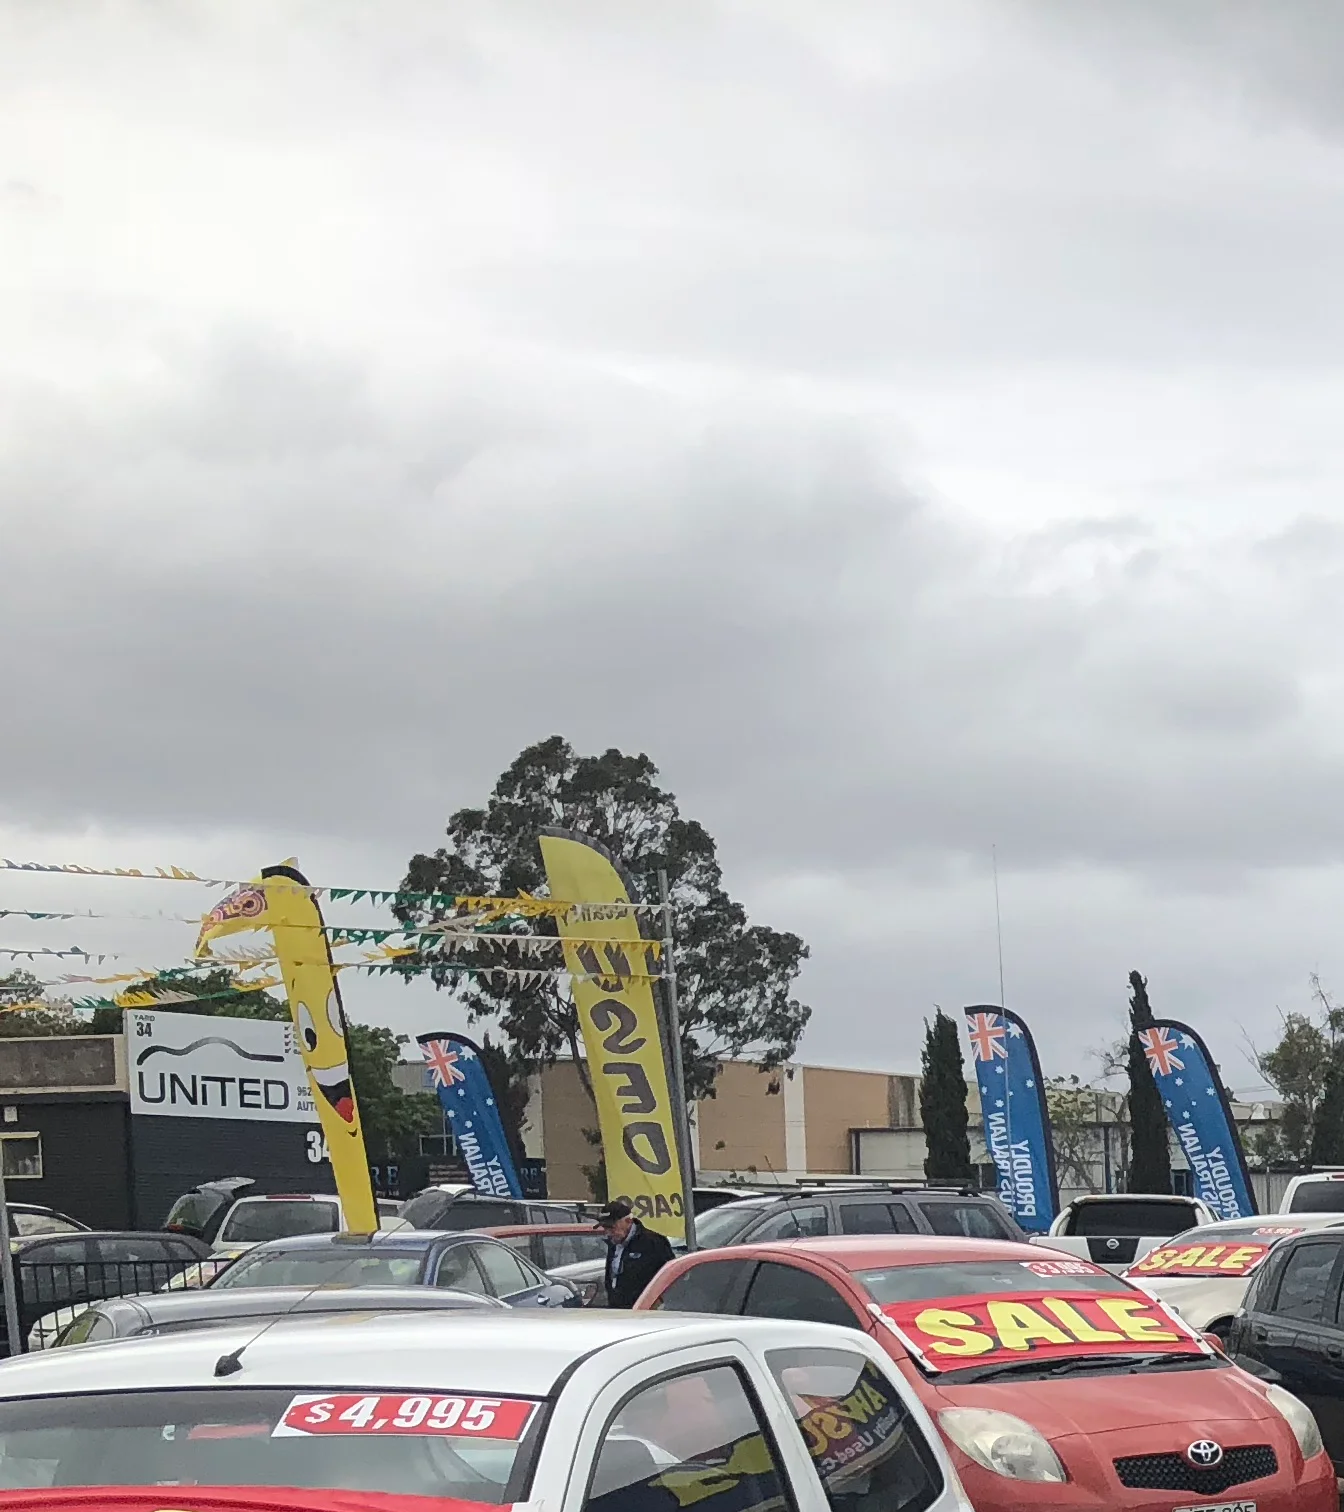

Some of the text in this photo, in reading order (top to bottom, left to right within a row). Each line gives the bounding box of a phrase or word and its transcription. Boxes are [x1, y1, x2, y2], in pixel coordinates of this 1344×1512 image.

[136, 1022, 153, 1037] 34
[137, 1071, 290, 1110] UNITED
[297, 1086, 313, 1098] 962
[1139, 1245, 1263, 1271] SALE
[914, 1296, 1181, 1357] SALE
[302, 1396, 502, 1433] $4,995
